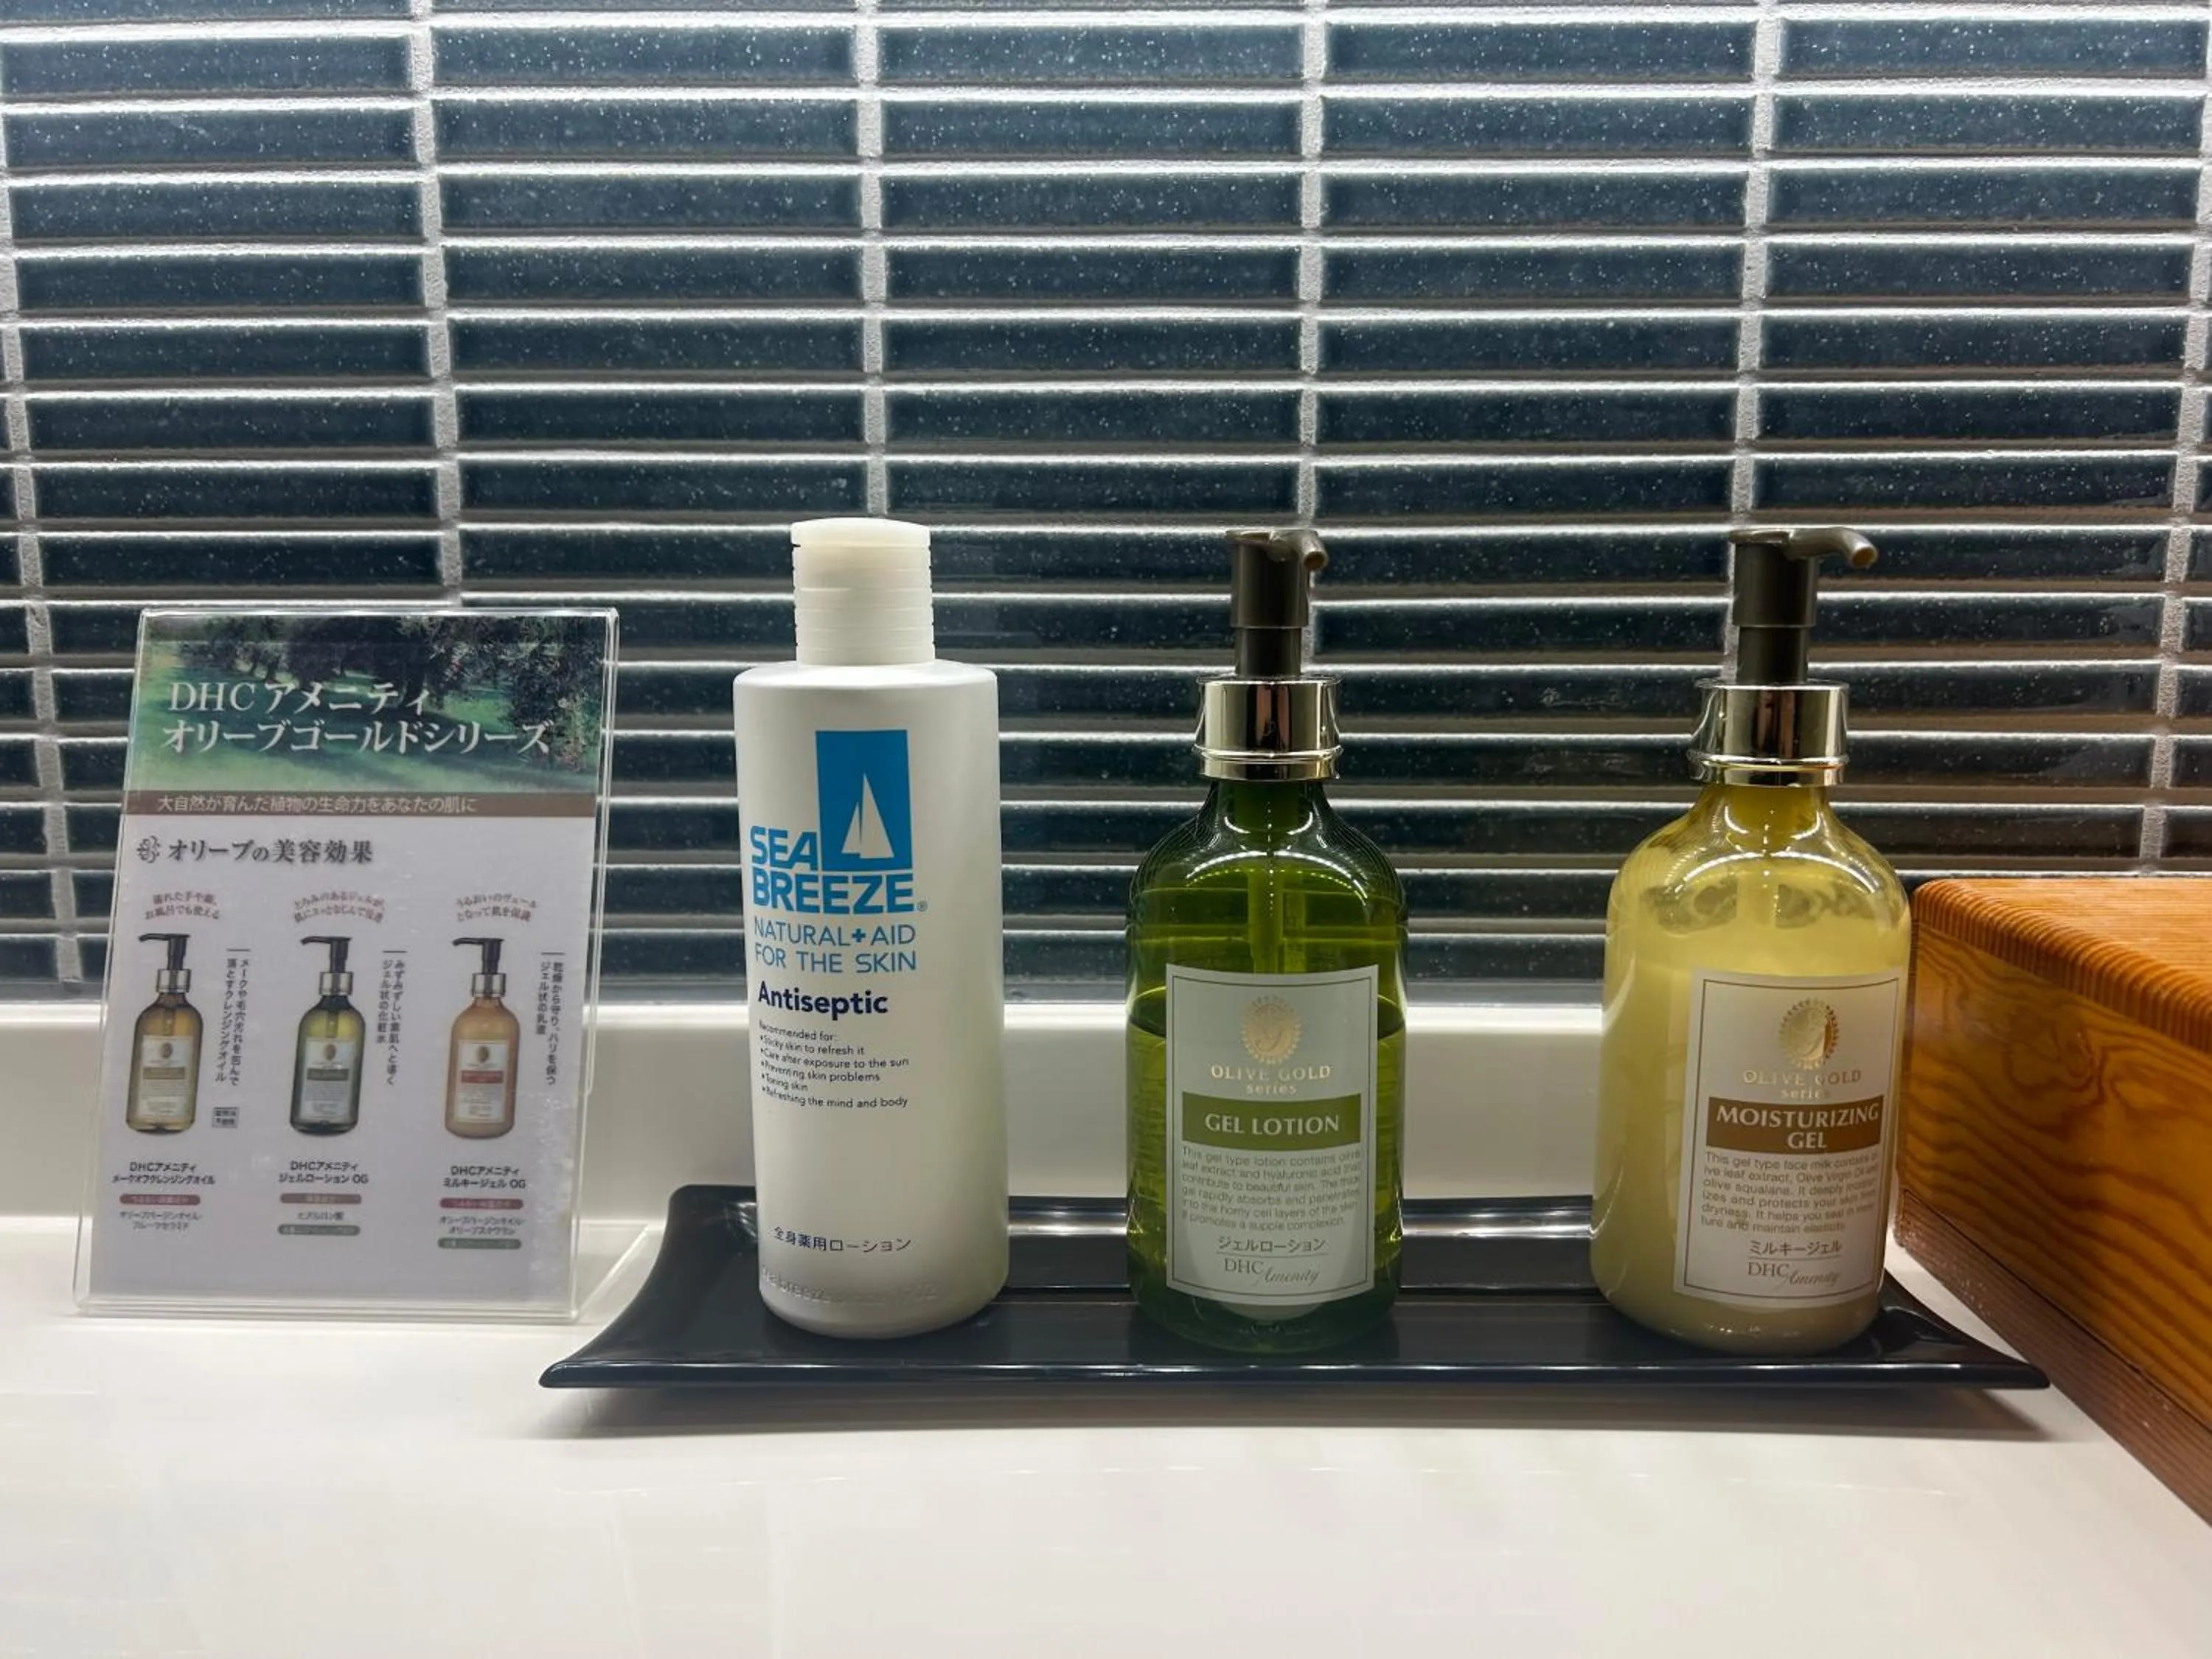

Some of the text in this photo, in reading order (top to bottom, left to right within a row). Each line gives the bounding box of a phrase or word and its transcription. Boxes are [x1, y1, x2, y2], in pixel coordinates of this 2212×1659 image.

[162, 718, 554, 754] オリーブゴールドシリーズ
[158, 795, 478, 812] 大自然が育んだ植物の生命力をあなたの肌に
[169, 839, 372, 864] オリーブの美容効果
[750, 825, 818, 871] SEA
[752, 867, 914, 914] BREEZE
[755, 943, 917, 973] FOR THE SKIN
[758, 980, 888, 1020] Antiseptic
[804, 1044, 815, 1054] to
[818, 1045, 854, 1055] refresh
[858, 1046, 865, 1055] it
[782, 1052, 802, 1065] after
[804, 1057, 851, 1070] exposure
[855, 1059, 866, 1068] to
[869, 1056, 887, 1067] the
[890, 1057, 910, 1067] sun
[807, 1068, 827, 1081] skin
[830, 1071, 881, 1082] problems
[1210, 1064, 1332, 1082] OLIVE GOLD
[1743, 1069, 1863, 1088] OLIVE GOLD
[790, 1080, 809, 1092] skin
[1245, 1082, 1297, 1095] series
[808, 1095, 824, 1106] the
[827, 1096, 853, 1108] mind
[857, 1097, 877, 1108] and
[880, 1096, 908, 1108] body
[1204, 1113, 1340, 1136] GEL LOTION
[1716, 1103, 1880, 1129] MOISTURIZING
[1787, 1131, 1828, 1150] GEL
[1206, 1153, 1222, 1164] gel
[1225, 1155, 1250, 1166] type
[1254, 1155, 1285, 1166] lotion
[1705, 1151, 1729, 1165] This
[1733, 1157, 1751, 1169] gel
[1753, 1159, 1781, 1172] type
[1783, 1159, 1808, 1170] face
[1239, 1168, 1260, 1179] and
[1321, 1166, 1341, 1178] acid
[1723, 1168, 1745, 1180] leaf
[1795, 1171, 1823, 1183] Olive
[1232, 1181, 1244, 1192] to
[1703, 1178, 1731, 1191] olive
[1198, 1190, 1234, 1203] rapidly
[1285, 1194, 1306, 1205] and
[1702, 1191, 1727, 1204] izes
[1731, 1195, 1755, 1206] and
[1759, 1196, 1810, 1209] protects
[1813, 1197, 1837, 1208] your
[1253, 1207, 1272, 1219] cell
[1275, 1208, 1306, 1220] layers
[1756, 1211, 1766, 1220] It
[1767, 1210, 1798, 1223] helps
[1802, 1211, 1823, 1223] you
[1239, 1220, 1246, 1229] a
[1701, 1215, 1723, 1228] ture
[1726, 1219, 1749, 1232] and
[1752, 1223, 1800, 1234] maintain
[773, 1226, 912, 1253] 全身薬用ローション
[1217, 1236, 1326, 1253] ジェルローション
[1749, 1239, 1843, 1257] ミルキージェル
[1224, 1259, 1265, 1276] DHC
[1747, 1262, 1790, 1277] DHC
